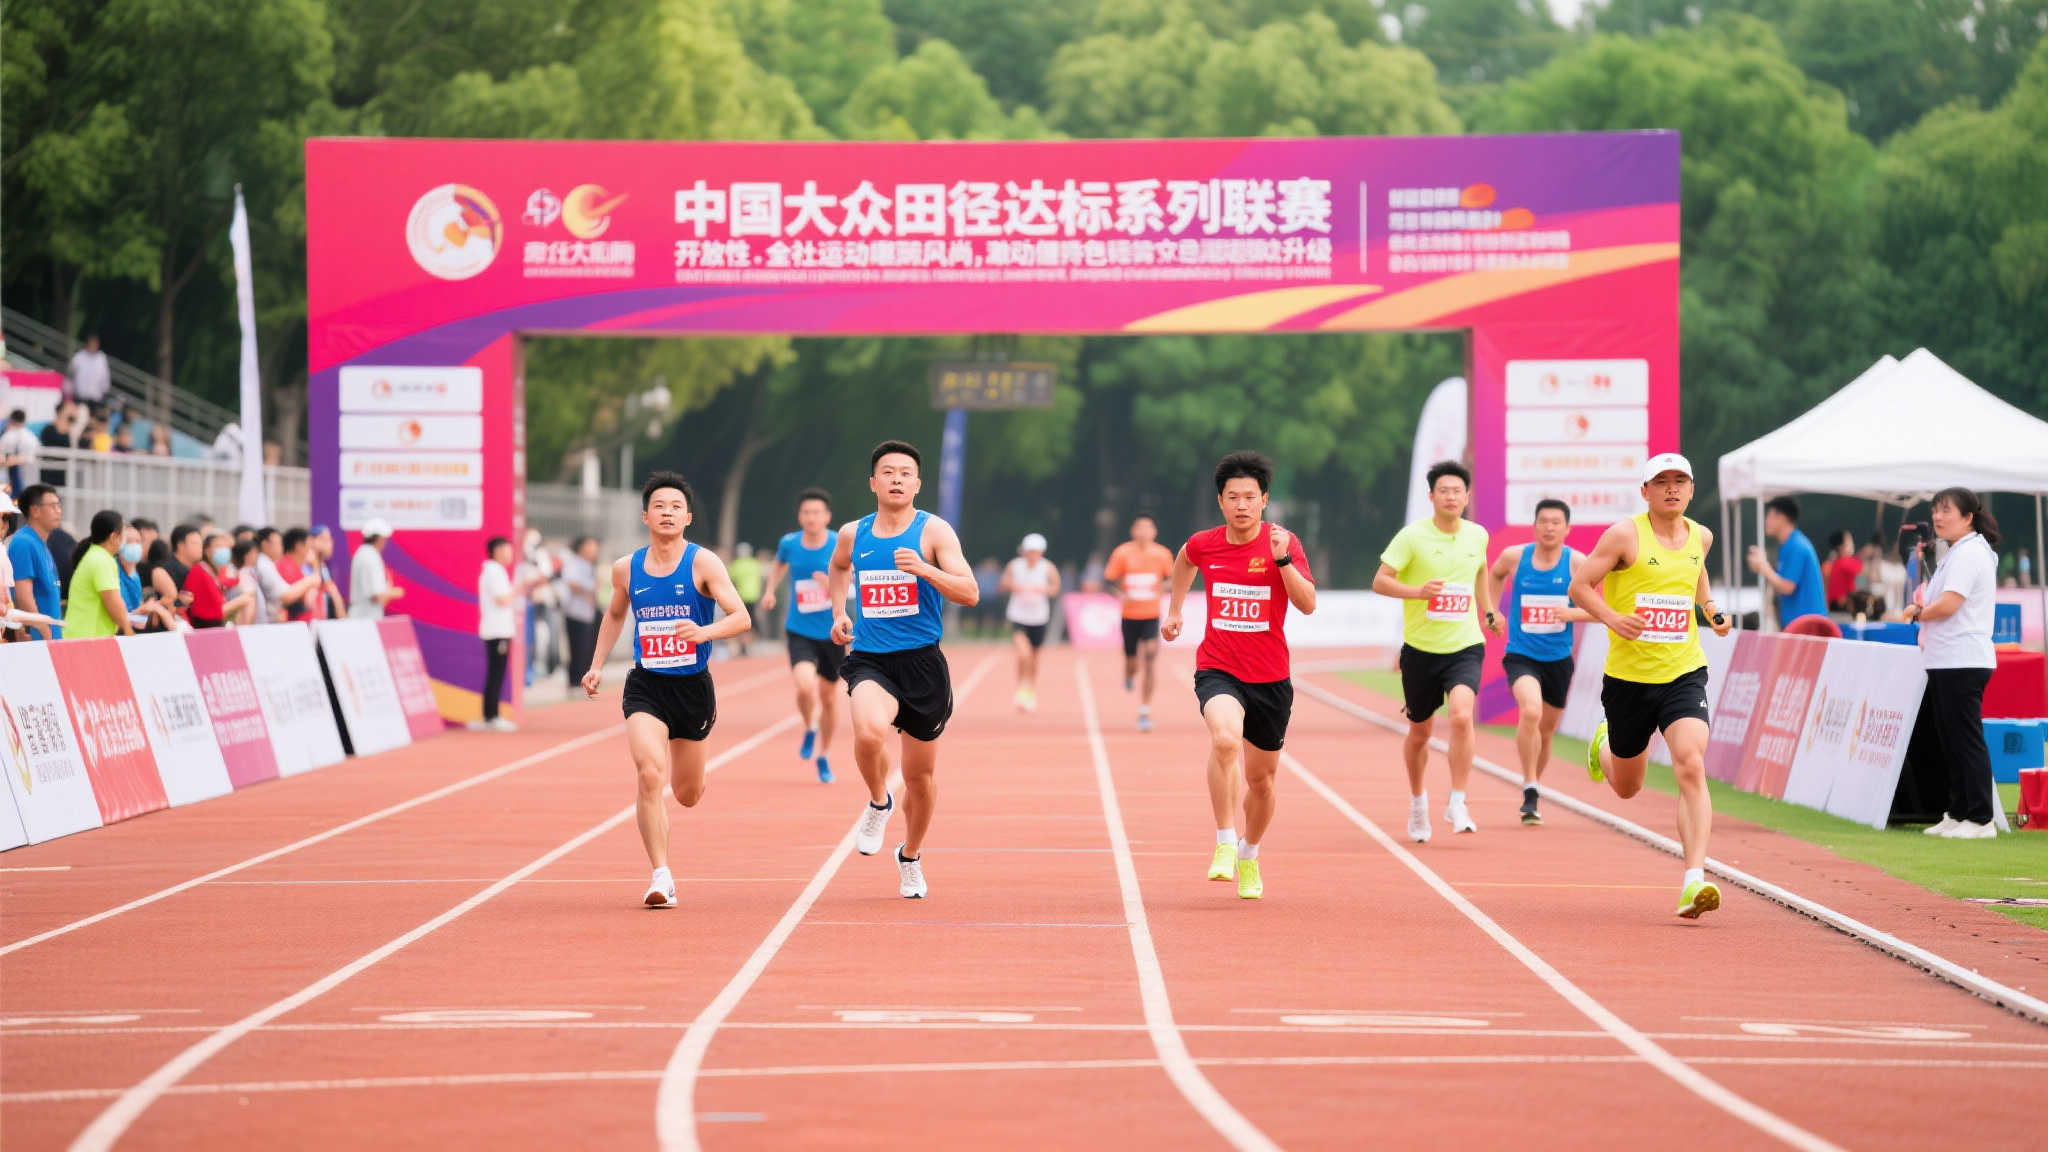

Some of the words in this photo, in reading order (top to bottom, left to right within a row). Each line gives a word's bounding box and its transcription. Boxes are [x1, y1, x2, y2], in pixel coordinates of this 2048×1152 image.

[675, 178, 1331, 237] 中国大众田径达标系列联赛
[1220, 599, 1260, 618] 2110
